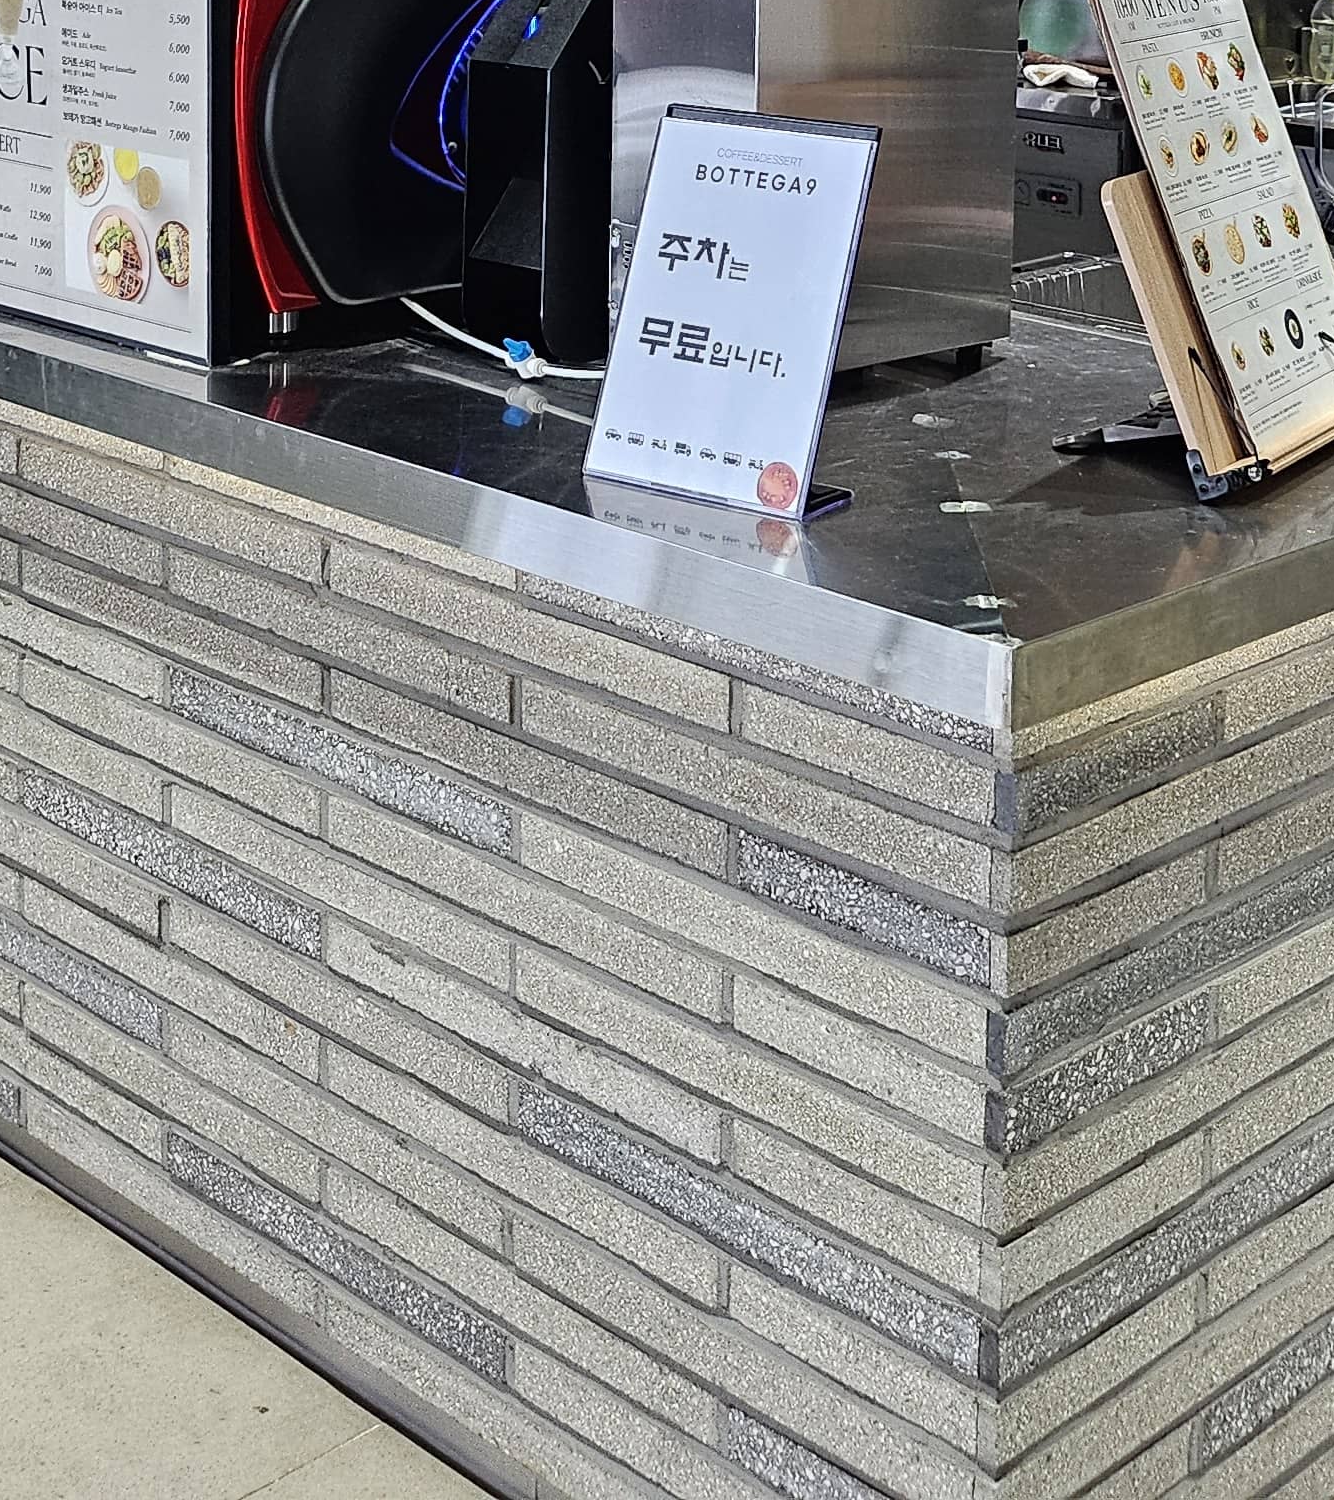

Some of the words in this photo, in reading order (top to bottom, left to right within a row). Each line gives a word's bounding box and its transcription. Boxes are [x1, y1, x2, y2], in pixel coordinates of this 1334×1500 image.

[168, 13, 191, 27] 5,500
[168, 42, 191, 56] 6,000
[168, 71, 191, 85] 6,000
[168, 100, 191, 114] 7,000
[169, 128, 191, 142] 7,000
[716, 147, 804, 167] COFFEE&DESSERT
[694, 163, 819, 196] BOTTEGA9
[30, 182, 52, 196] 11,900
[30, 209, 52, 223] 12,900
[29, 236, 52, 250] 11,900
[656, 231, 750, 282] 주차는
[34, 264, 53, 278] 7,000
[637, 315, 787, 379] 무료입니다.
